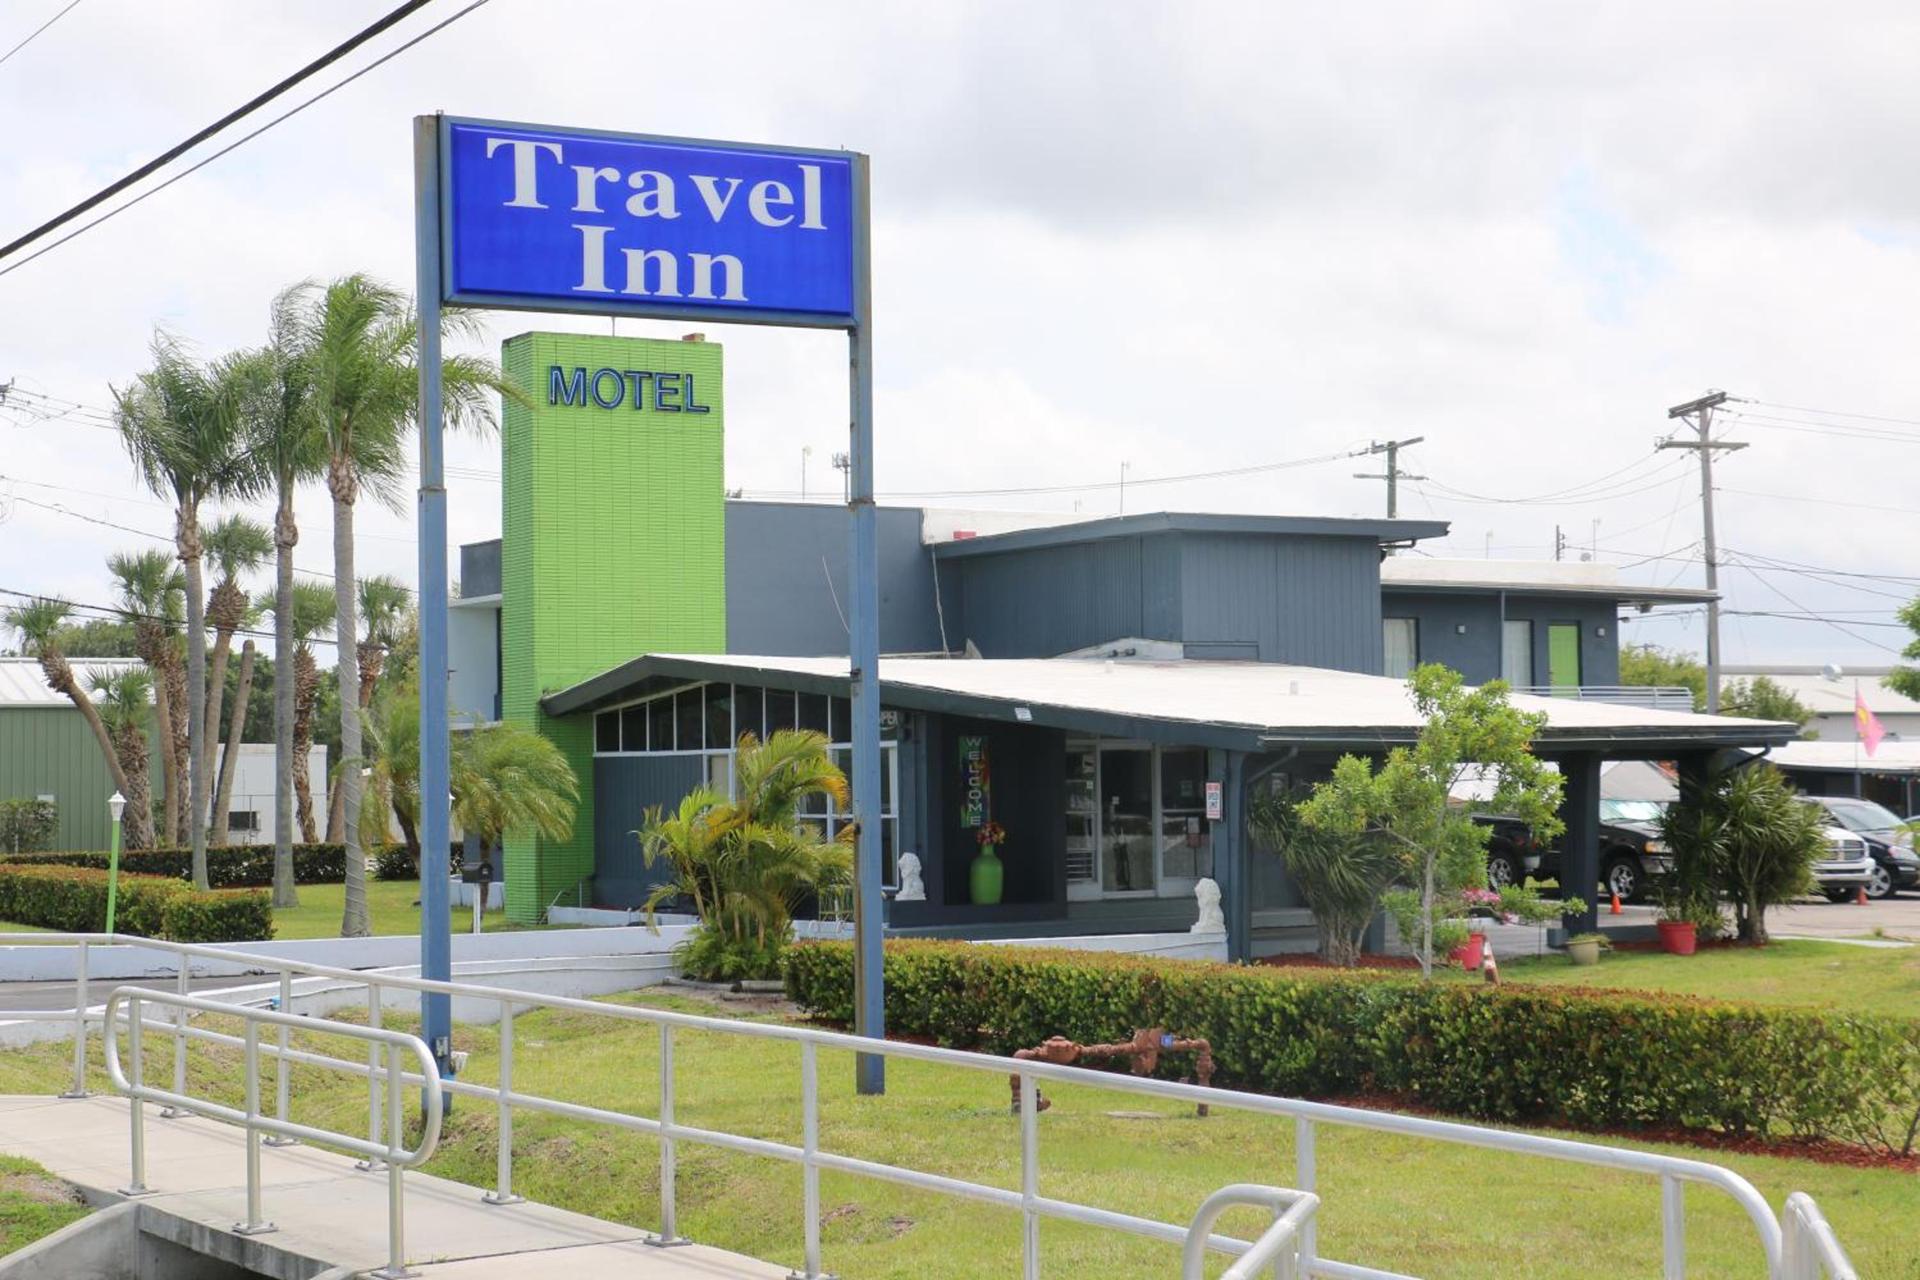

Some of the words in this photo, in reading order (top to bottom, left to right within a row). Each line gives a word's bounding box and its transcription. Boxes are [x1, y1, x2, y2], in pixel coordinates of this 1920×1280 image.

[486, 138, 827, 230] Travel
[572, 224, 748, 301] Inn
[549, 366, 710, 413] MOTEL
[966, 737, 982, 825] WELCOME
